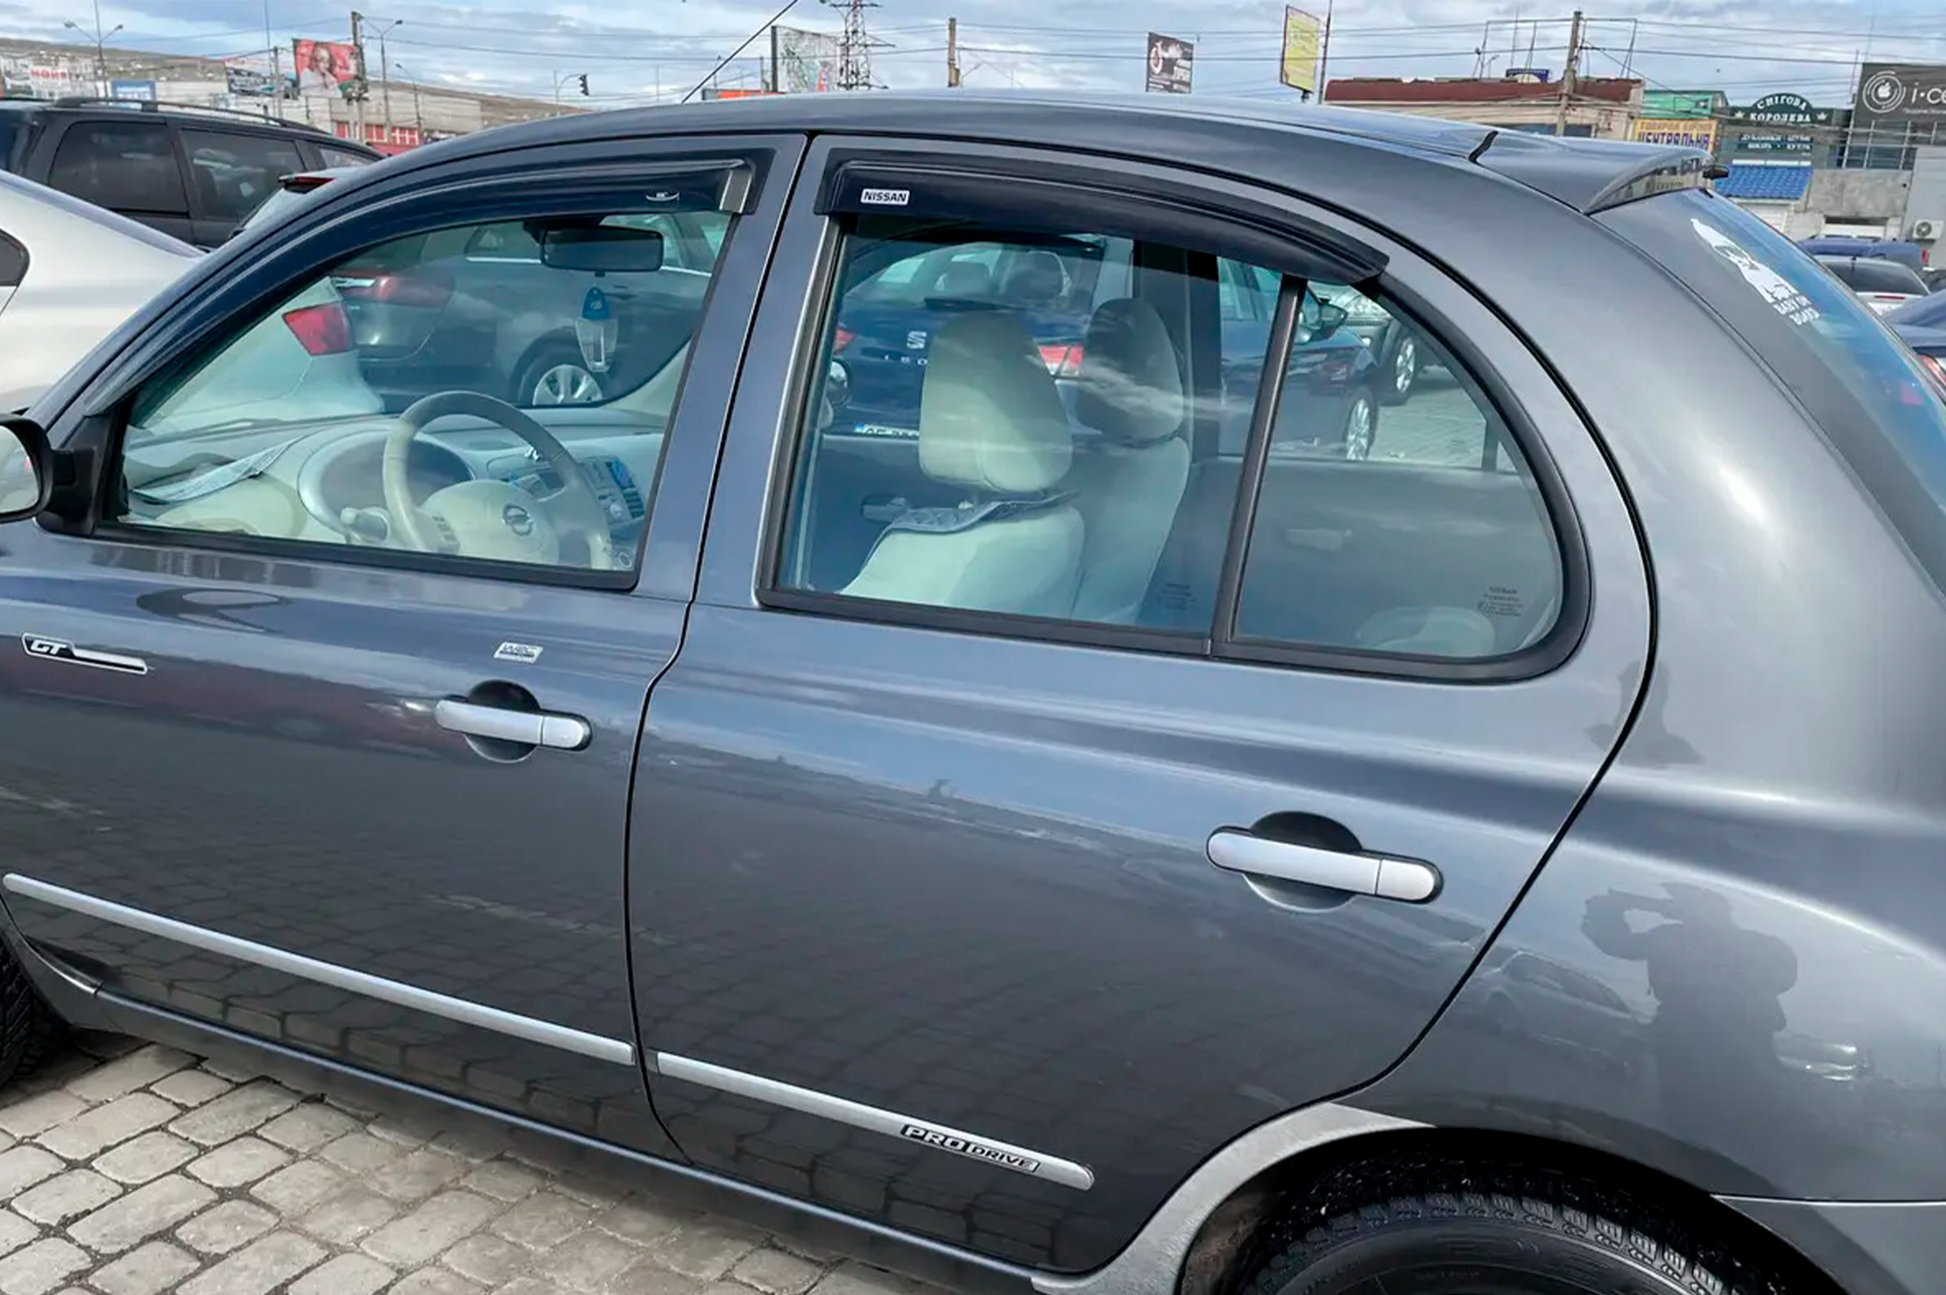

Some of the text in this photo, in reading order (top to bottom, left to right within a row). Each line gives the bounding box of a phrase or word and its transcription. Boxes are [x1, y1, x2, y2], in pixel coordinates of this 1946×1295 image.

[1749, 112, 1811, 122] КОРОЛЕВА
[864, 190, 907, 202] NISSAN
[30, 639, 67, 655] GT
[904, 1125, 966, 1151] PRO
